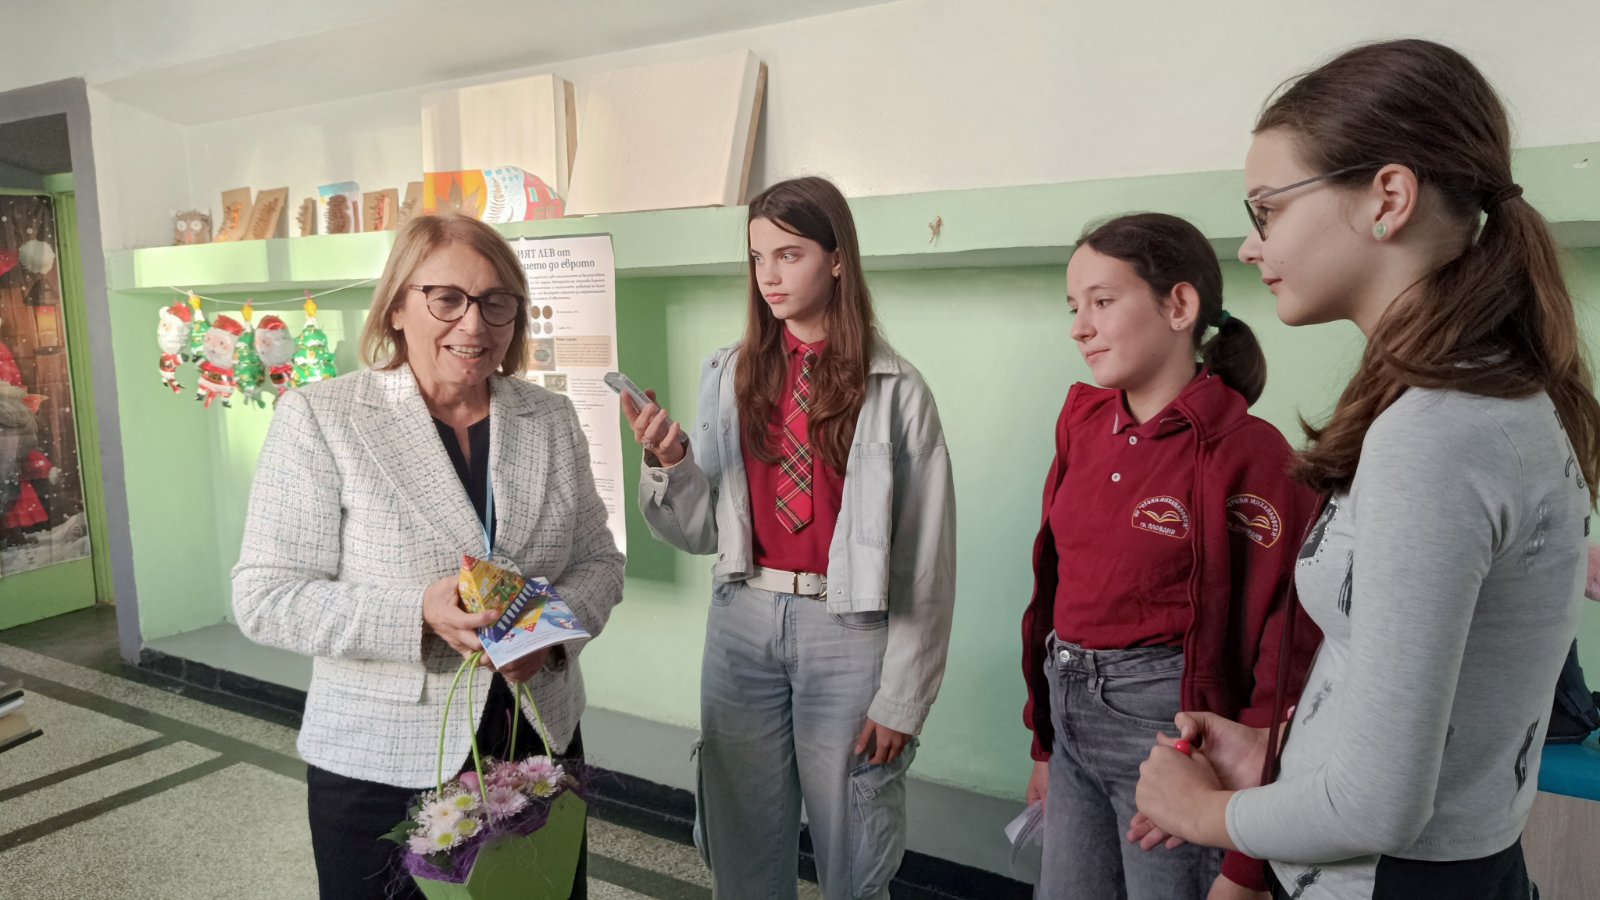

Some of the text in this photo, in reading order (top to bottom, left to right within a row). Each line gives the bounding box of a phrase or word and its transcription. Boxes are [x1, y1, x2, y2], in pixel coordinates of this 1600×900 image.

[538, 248, 555, 258] ЛЕВ
[557, 249, 571, 257] от
[549, 262, 559, 271] до
[561, 259, 595, 271] еврото
